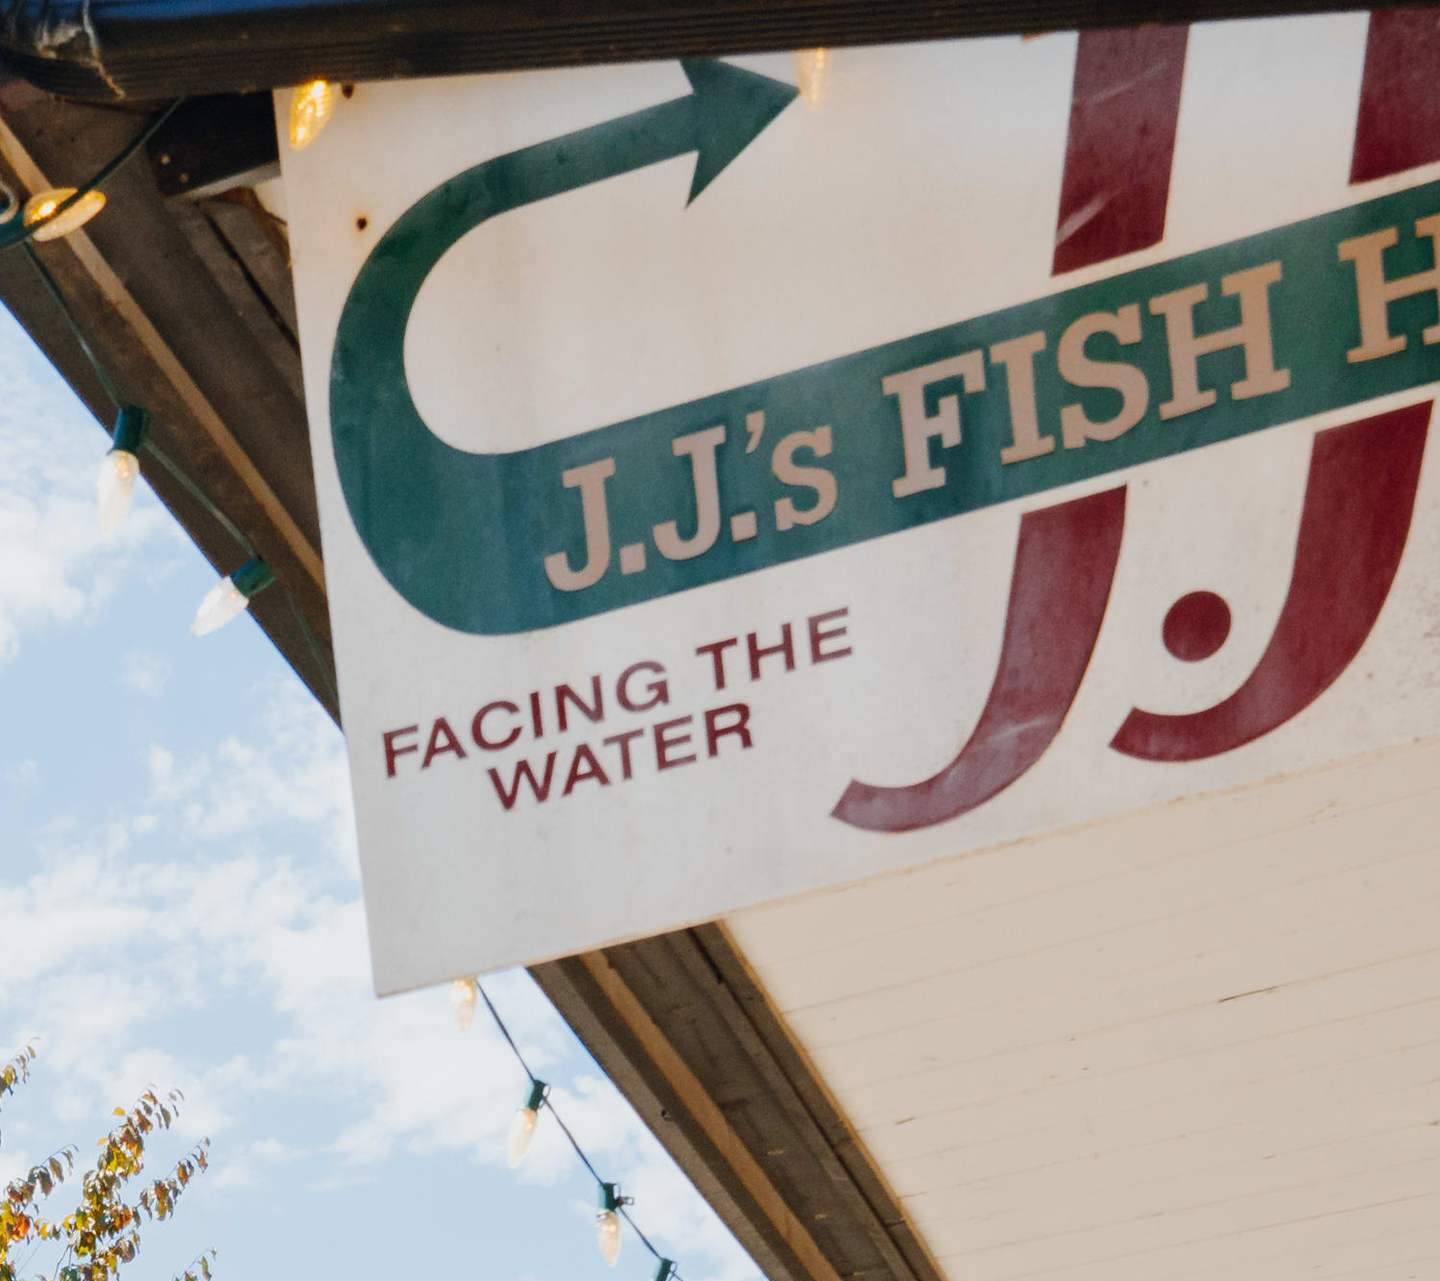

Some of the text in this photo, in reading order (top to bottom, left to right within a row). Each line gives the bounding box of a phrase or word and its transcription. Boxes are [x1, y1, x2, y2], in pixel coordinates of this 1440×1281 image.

[544, 410, 838, 593] J.J.'s
[882, 260, 1294, 500] FISH
[382, 606, 854, 778] FACING THE
[487, 700, 755, 811] WATER
